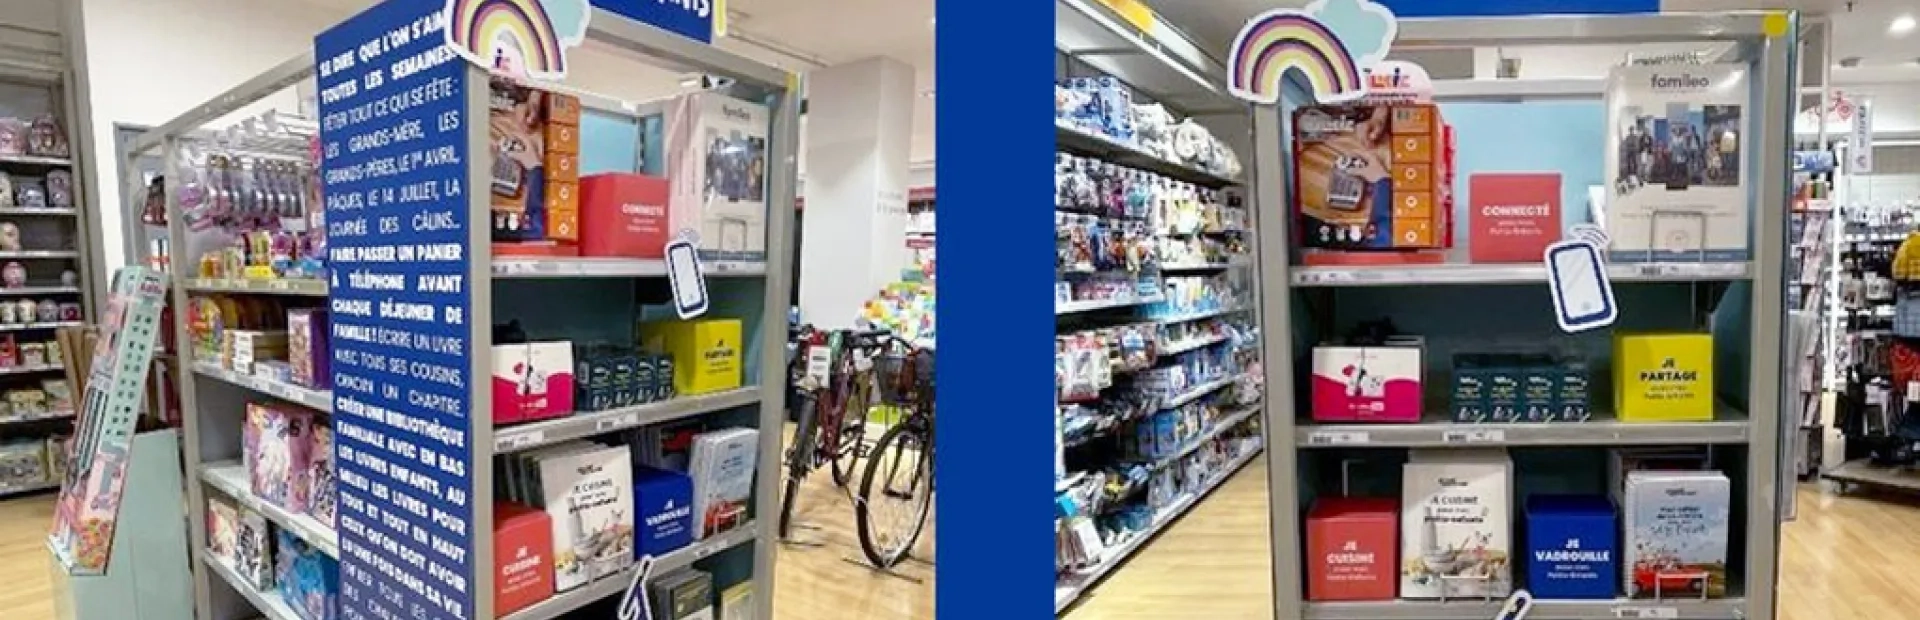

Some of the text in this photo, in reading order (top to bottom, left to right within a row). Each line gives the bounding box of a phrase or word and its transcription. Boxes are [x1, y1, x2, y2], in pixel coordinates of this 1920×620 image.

[320, 10, 445, 77] SE DIRE QUE L'ON S'AIM
[322, 79, 357, 104] TOUTES
[364, 69, 384, 90] LES
[1651, 73, 1709, 88] famileo
[348, 102, 373, 125] TOUT
[374, 97, 389, 117] CE
[389, 92, 410, 114] QUI
[410, 86, 424, 106] SE
[325, 142, 340, 159] LES
[437, 110, 460, 132] LES
[399, 153, 410, 173] LE
[368, 188, 379, 207] LE
[382, 187, 394, 203] 14
[444, 178, 461, 197] LA
[1481, 201, 1551, 217] CONNECTÉ
[329, 216, 367, 237] JOURNÉE
[379, 216, 400, 235] DES
[330, 243, 462, 262] FAIRE PASSER UN PANIER
[349, 268, 405, 291] TÉLÉPHONE
[418, 275, 462, 293] AVANT
[332, 296, 463, 324] CHAQUE DÉJEUNER DE
[413, 333, 430, 351] UN
[432, 335, 463, 356] LIVRE
[335, 349, 359, 366] AVEC
[361, 351, 386, 372] TOUS
[389, 357, 408, 376] SES
[1661, 357, 1674, 368] JE
[1640, 370, 1697, 382] PARTAGE
[382, 381, 399, 400] UN
[385, 409, 464, 447] BIBLIOTHÈQUE
[337, 421, 465, 477] FAMILIALE AVEC EN BAS
[338, 444, 353, 461] LES
[355, 450, 387, 475] LIVRES
[446, 485, 466, 506] AU
[339, 467, 466, 536] MILIEU LES LIVRES POUR
[1441, 496, 1479, 506] CUISINE
[340, 491, 466, 564] TOUS ET TOUT EN HAUT
[341, 514, 365, 537] CEUX
[400, 545, 426, 570] DOIT
[428, 561, 466, 593] AVOIR
[1535, 549, 1610, 562] VADROUILLE
[1565, 538, 1580, 549] JE
[1326, 552, 1375, 564] CUISINE
[353, 543, 372, 564] UNE
[372, 553, 395, 577] FOIS
[395, 566, 424, 595] DANS
[426, 585, 442, 607] SA
